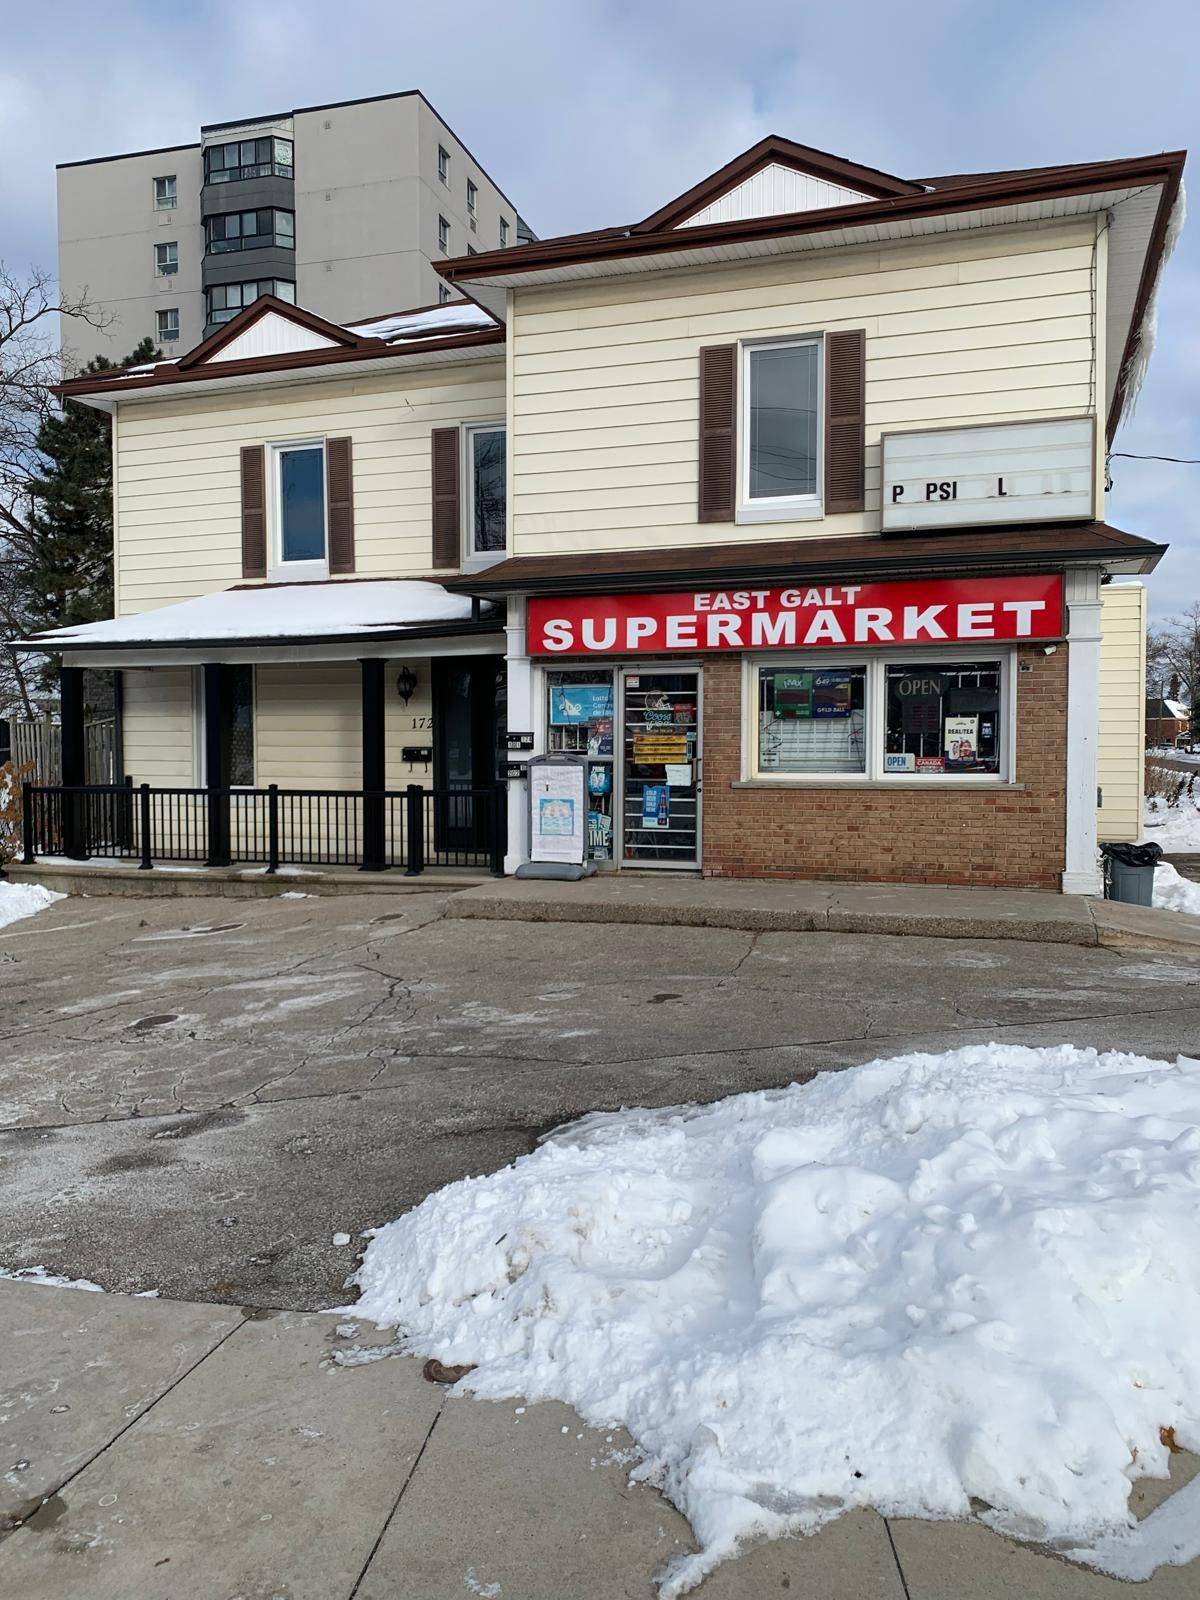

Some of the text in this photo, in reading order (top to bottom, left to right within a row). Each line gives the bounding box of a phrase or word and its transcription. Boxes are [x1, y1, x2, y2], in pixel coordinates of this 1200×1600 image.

[892, 484, 905, 503] P
[926, 481, 958, 501] PSI
[693, 585, 862, 612] EAST GALT
[541, 599, 1046, 652] SUPERMARKET
[898, 679, 941, 696] OPEN
[411, 717, 433, 729] 172
[887, 756, 906, 766] OPEN
